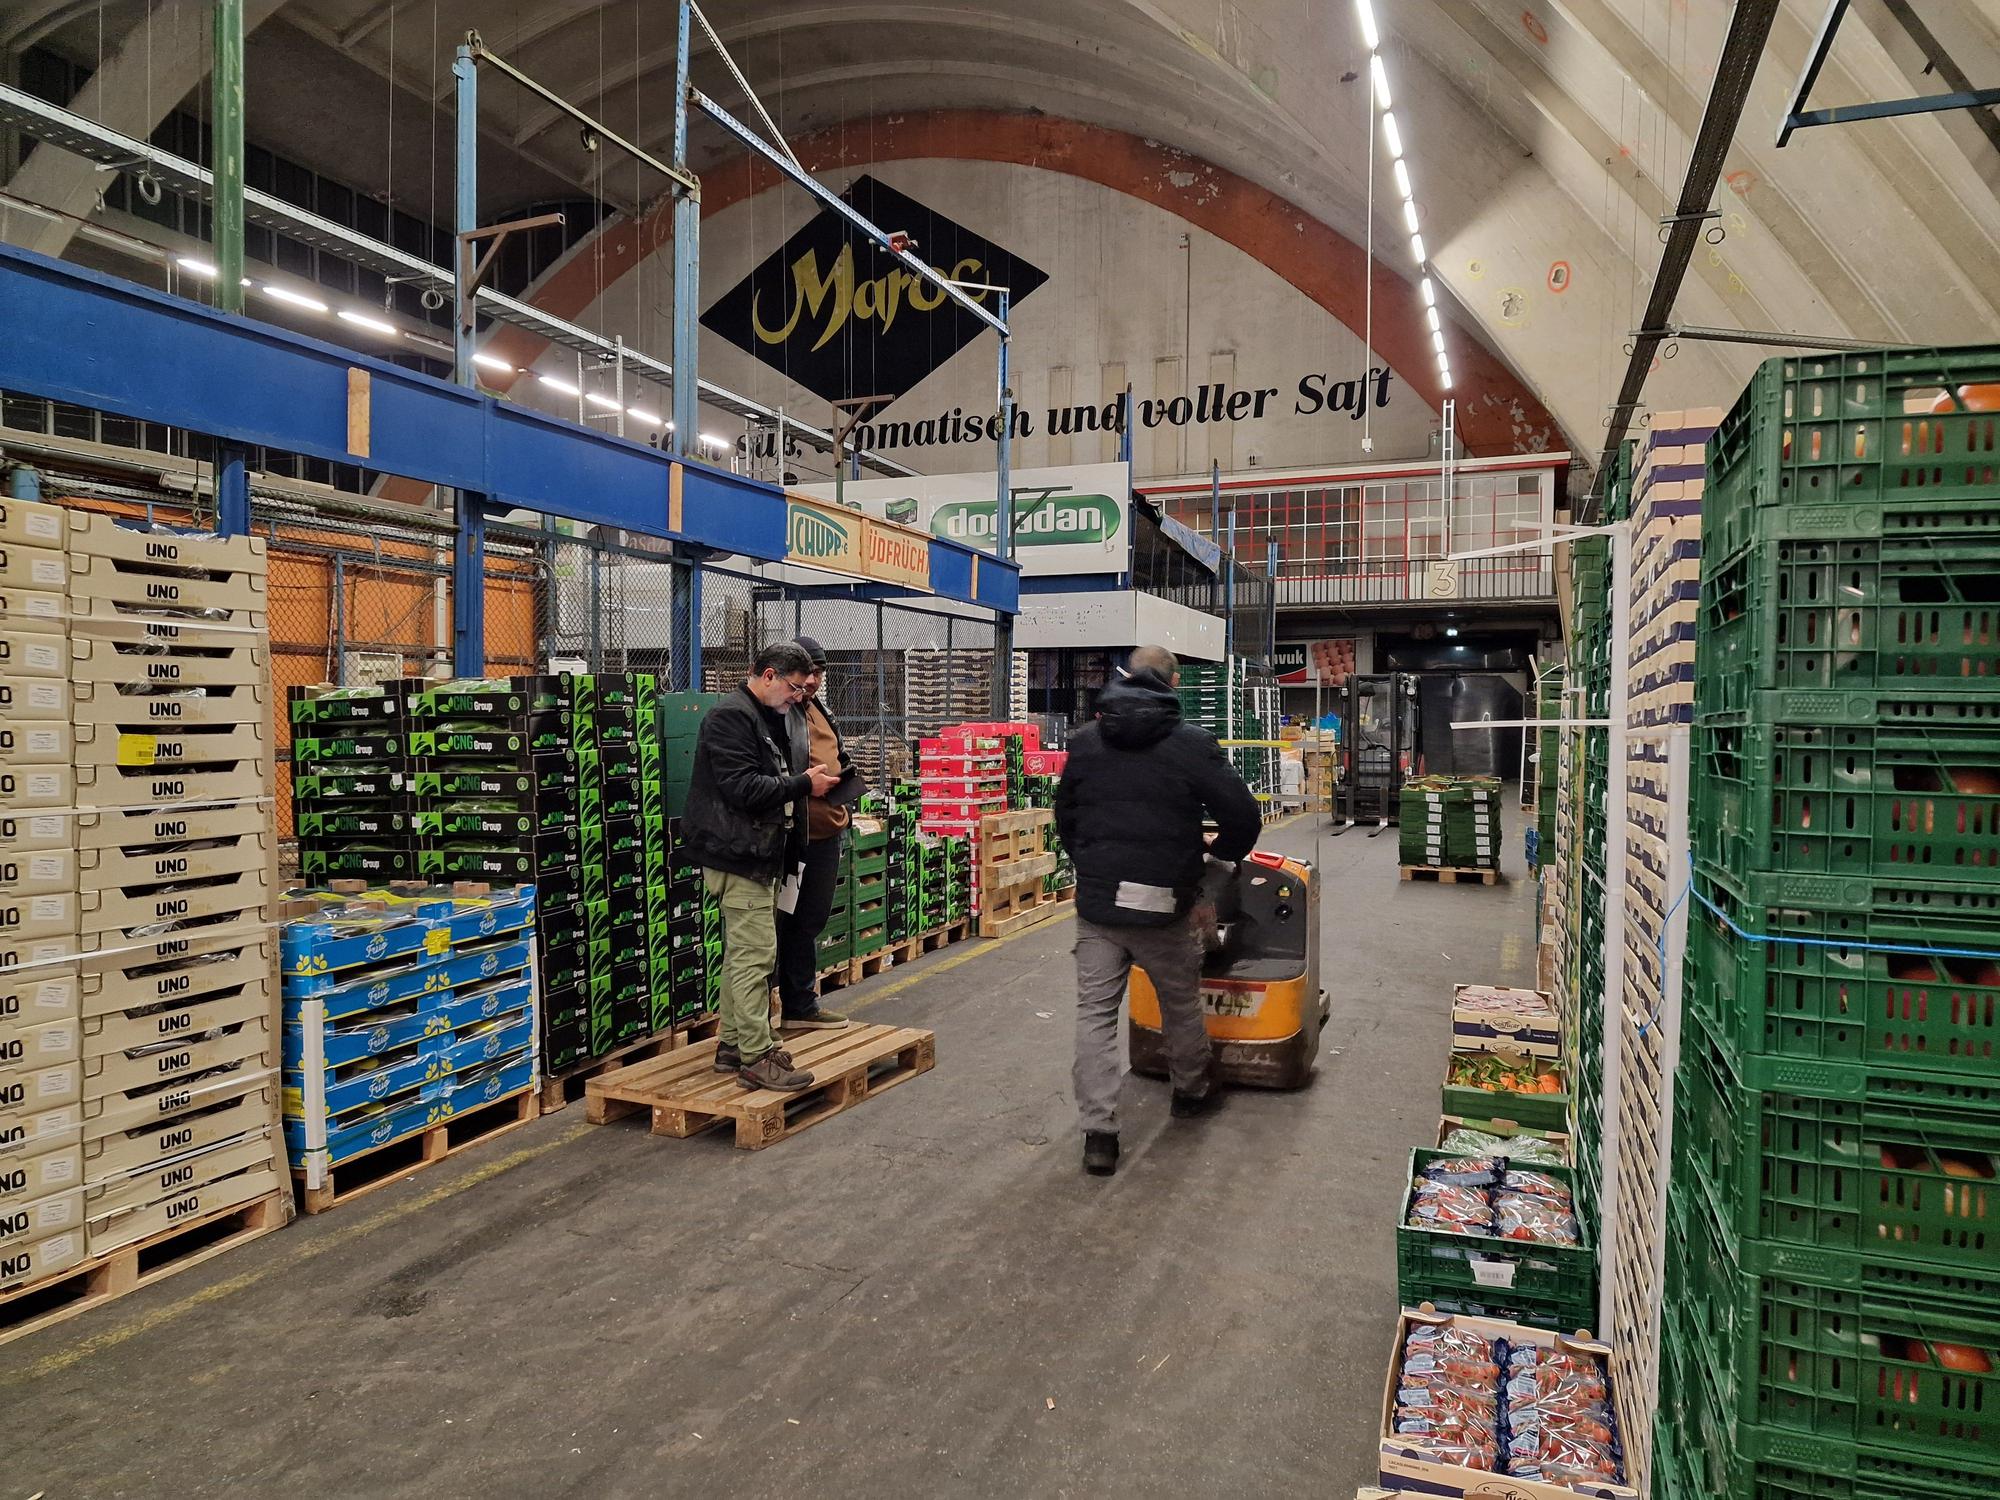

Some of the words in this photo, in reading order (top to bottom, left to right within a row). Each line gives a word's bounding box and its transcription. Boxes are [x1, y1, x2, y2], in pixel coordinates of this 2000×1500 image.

[752, 241, 989, 352] Maroc
[816, 403, 1034, 453] omatisch
[1047, 392, 1127, 436] und
[1138, 383, 1278, 428] voller
[1295, 366, 1393, 420] Saft
[146, 543, 178, 559] UNO
[1432, 562, 1456, 597] 3
[147, 584, 178, 600] UNO
[148, 664, 179, 678] UNO
[150, 703, 181, 716] UNO
[351, 706, 369, 717] Group
[453, 695, 473, 711] CNG
[473, 701, 493, 712] Group
[336, 740, 355, 755] CNG
[355, 745, 373, 755] Group
[453, 735, 473, 750] CNG
[473, 740, 493, 752] Group
[153, 781, 184, 796] UNO
[460, 776, 480, 791] CNG
[480, 781, 501, 793] Group
[155, 821, 187, 836] UNO
[359, 821, 378, 832] Group
[461, 816, 481, 831] CNG
[482, 821, 502, 833] Group
[156, 859, 187, 875] UNO
[362, 859, 380, 870] Group
[463, 855, 482, 870] CNG
[483, 860, 502, 872] Group
[157, 900, 187, 917] UNO
[157, 940, 188, 955] UNO
[158, 976, 189, 994] UNO
[159, 1014, 190, 1032] UNO
[0, 1040, 23, 1060] NO
[159, 1052, 190, 1071] UNO
[0, 1084, 25, 1104] NO
[0, 1126, 25, 1144] NO
[160, 1129, 191, 1150] UNO
[0, 1169, 26, 1193] NO
[161, 1166, 193, 1188] UNO
[167, 1197, 198, 1219] UNO
[0, 1212, 29, 1237] NO
[1, 1253, 31, 1278] NO
